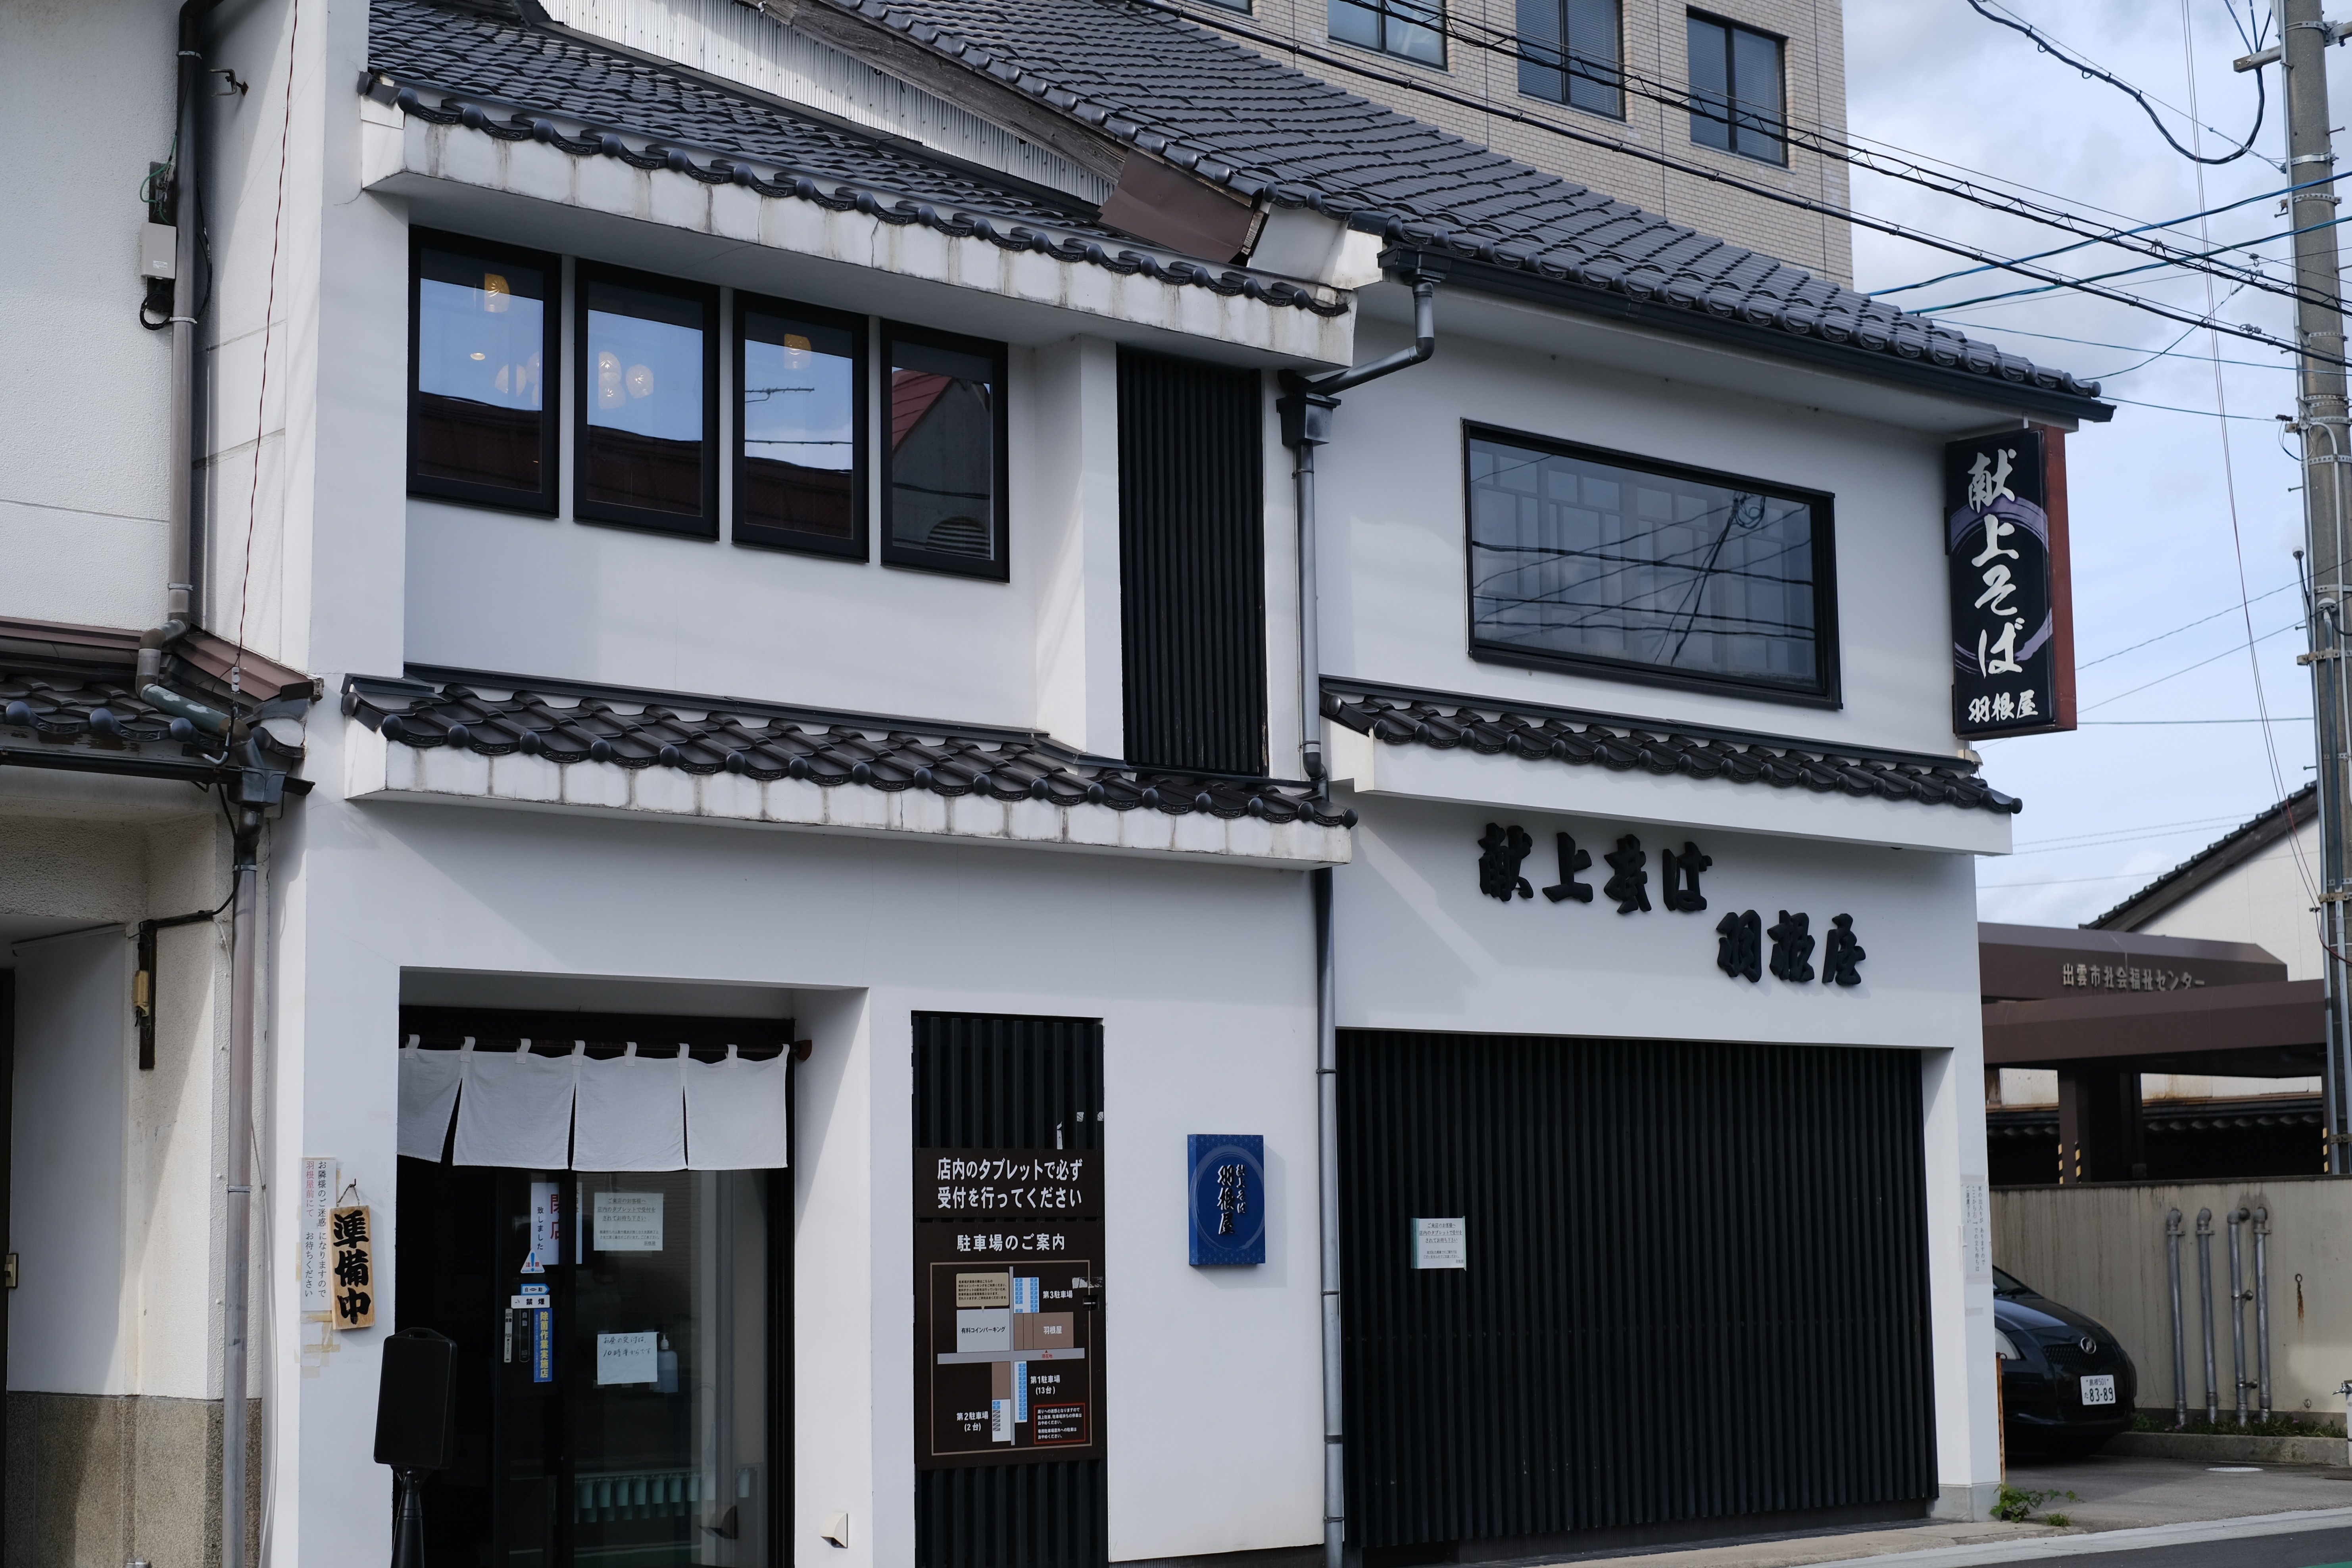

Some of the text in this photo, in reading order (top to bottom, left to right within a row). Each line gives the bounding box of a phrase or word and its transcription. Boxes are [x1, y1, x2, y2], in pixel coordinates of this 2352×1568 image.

[1968, 448, 2024, 678] 献上そば
[1968, 689, 2039, 723] 羽根屋
[2063, 963, 2205, 992] 出雲市社会福祉センター
[937, 1157, 1083, 1181] 店内のタブレットで必ず
[938, 1186, 1082, 1209] 受付を行ってください
[305, 1161, 314, 1297] 羽根屋前にて お待ちください
[957, 1233, 1065, 1252] 駐車場のご案内
[333, 1210, 371, 1325] 準備中
[1043, 1290, 1073, 1299] 第3駐車場
[1043, 1326, 1062, 1335] 羽根屋
[540, 1311, 549, 1378] 除菌作業実施店
[1030, 1375, 1060, 1384] 第1駐車場
[957, 1411, 988, 1421] 第2駐車場
